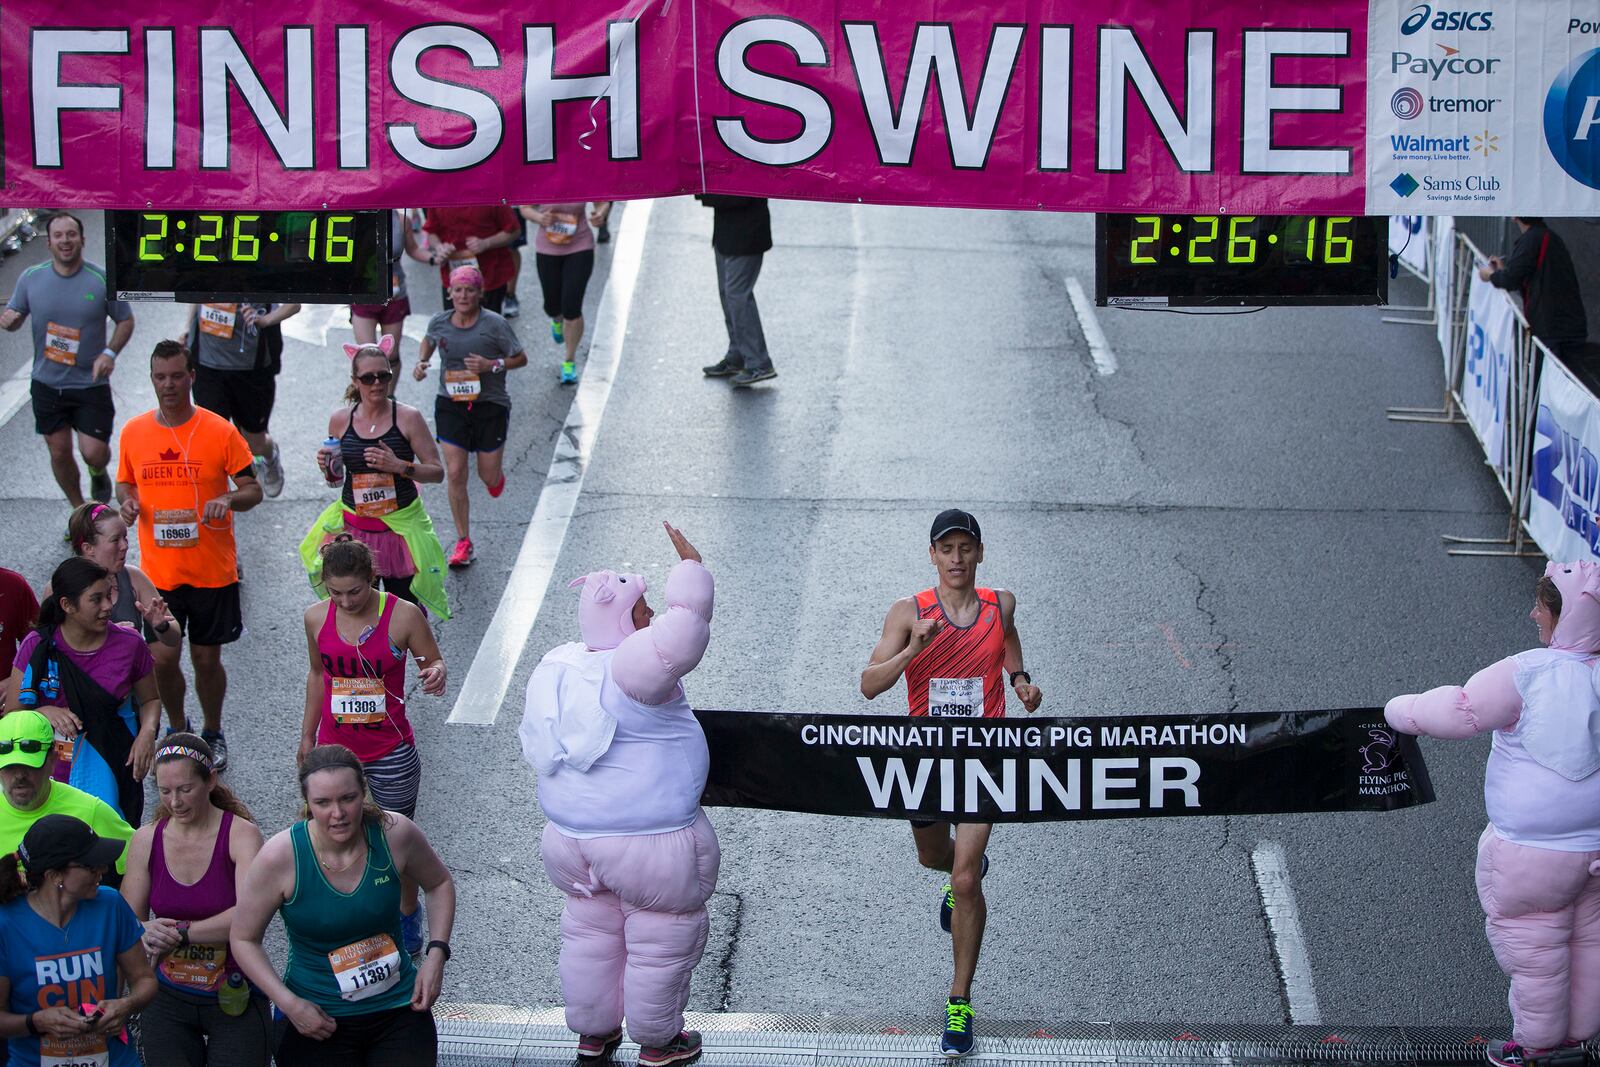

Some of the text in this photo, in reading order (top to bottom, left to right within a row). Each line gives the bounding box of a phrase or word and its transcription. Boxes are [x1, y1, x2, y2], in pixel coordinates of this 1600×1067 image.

[1391, 51, 1501, 81] Paycor
[29, 15, 1353, 177] FINISH SWINE
[1390, 135, 1470, 152] Walmart
[1423, 175, 1500, 191] Sam's Club
[1426, 194, 1453, 202] Savings
[1474, 194, 1496, 202] Simple
[142, 466, 201, 480] QUEEN CITY
[320, 653, 384, 679] RUN
[341, 701, 377, 713] 11308
[942, 703, 972, 716] 4386
[801, 722, 1247, 748] CINCINNATI FLYING PIG MARATHON
[856, 756, 1202, 814] WINNER
[1359, 771, 1408, 785] FLYING PIG
[1359, 782, 1411, 795] MARATHON
[374, 875, 390, 886] FILA
[340, 941, 390, 962] HALF MARATHON
[344, 940, 370, 954] FLYING
[35, 950, 104, 986] RUN
[350, 963, 392, 990] 11381
[37, 975, 106, 1013] CIN
